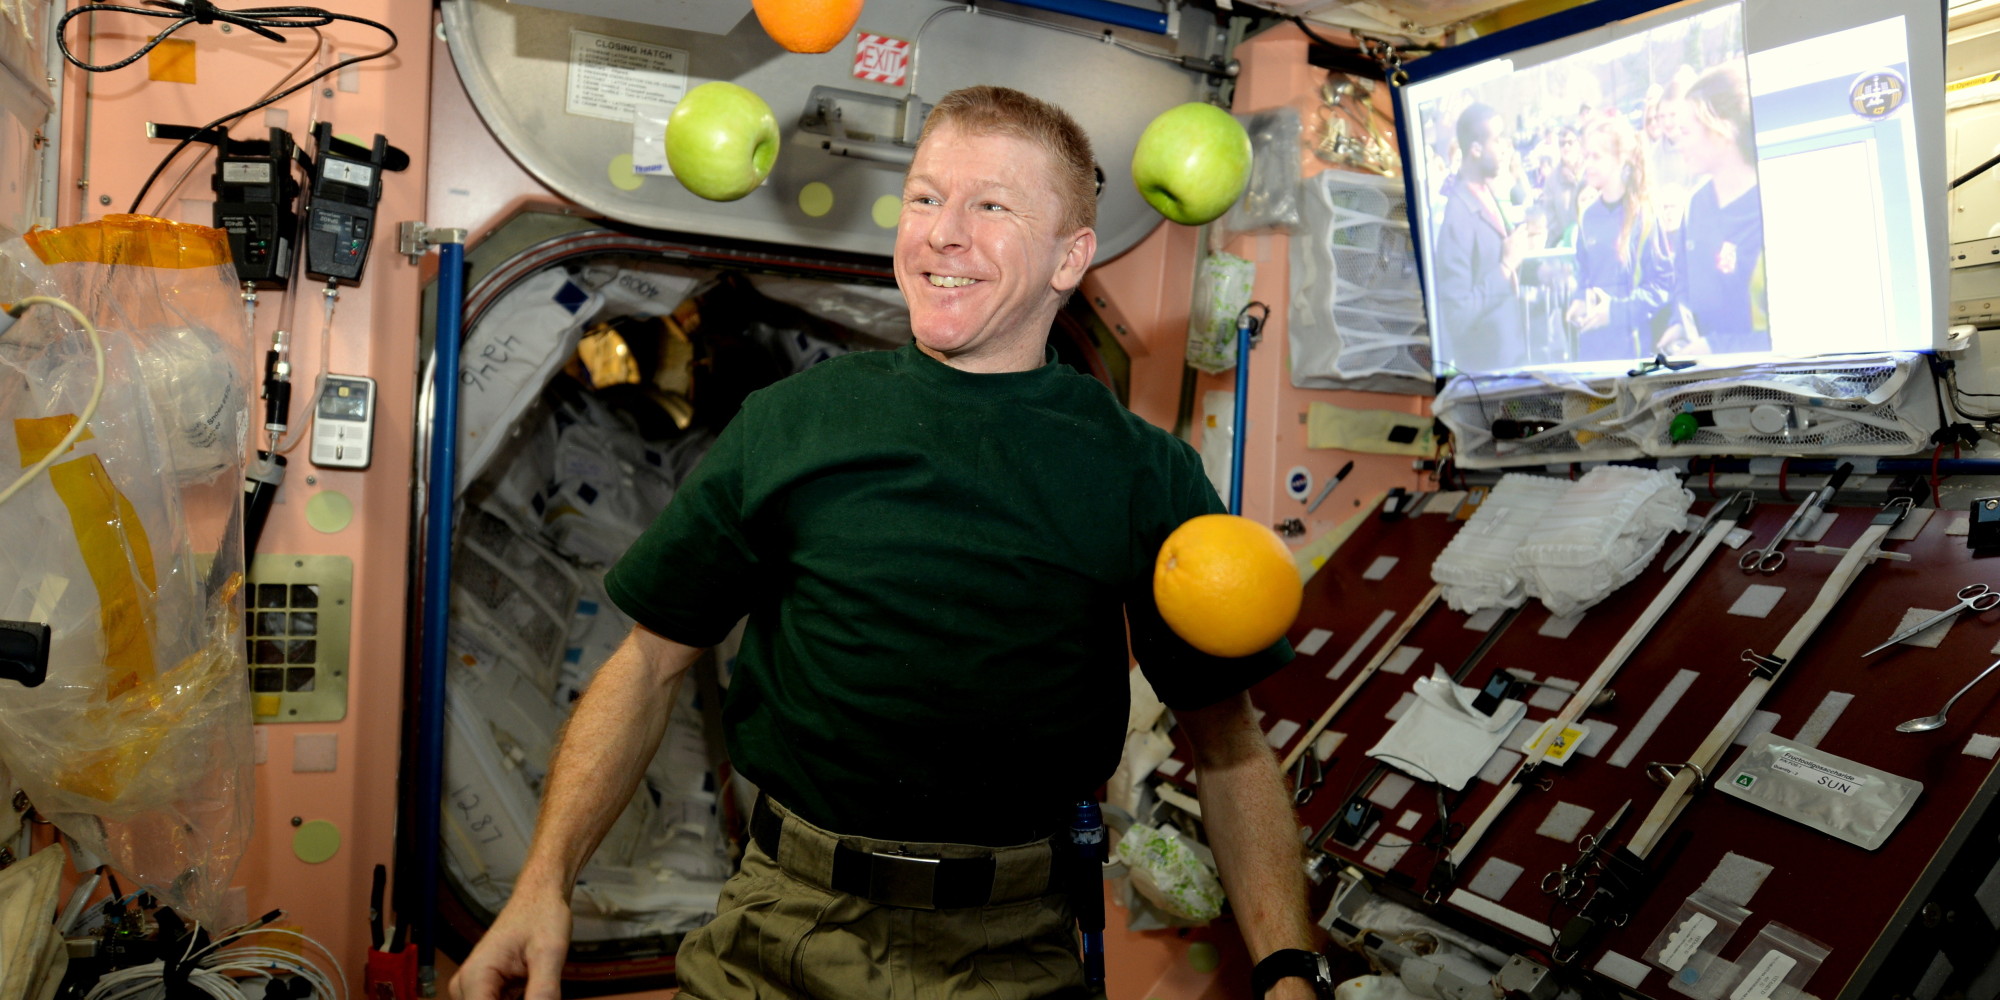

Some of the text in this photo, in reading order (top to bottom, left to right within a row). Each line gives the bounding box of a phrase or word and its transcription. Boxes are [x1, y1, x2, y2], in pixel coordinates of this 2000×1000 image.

[595, 39, 673, 60] CLOSING HATCH
[863, 45, 901, 74] EXIT
[1817, 775, 1852, 794] SUN
[451, 783, 503, 844] 1287
